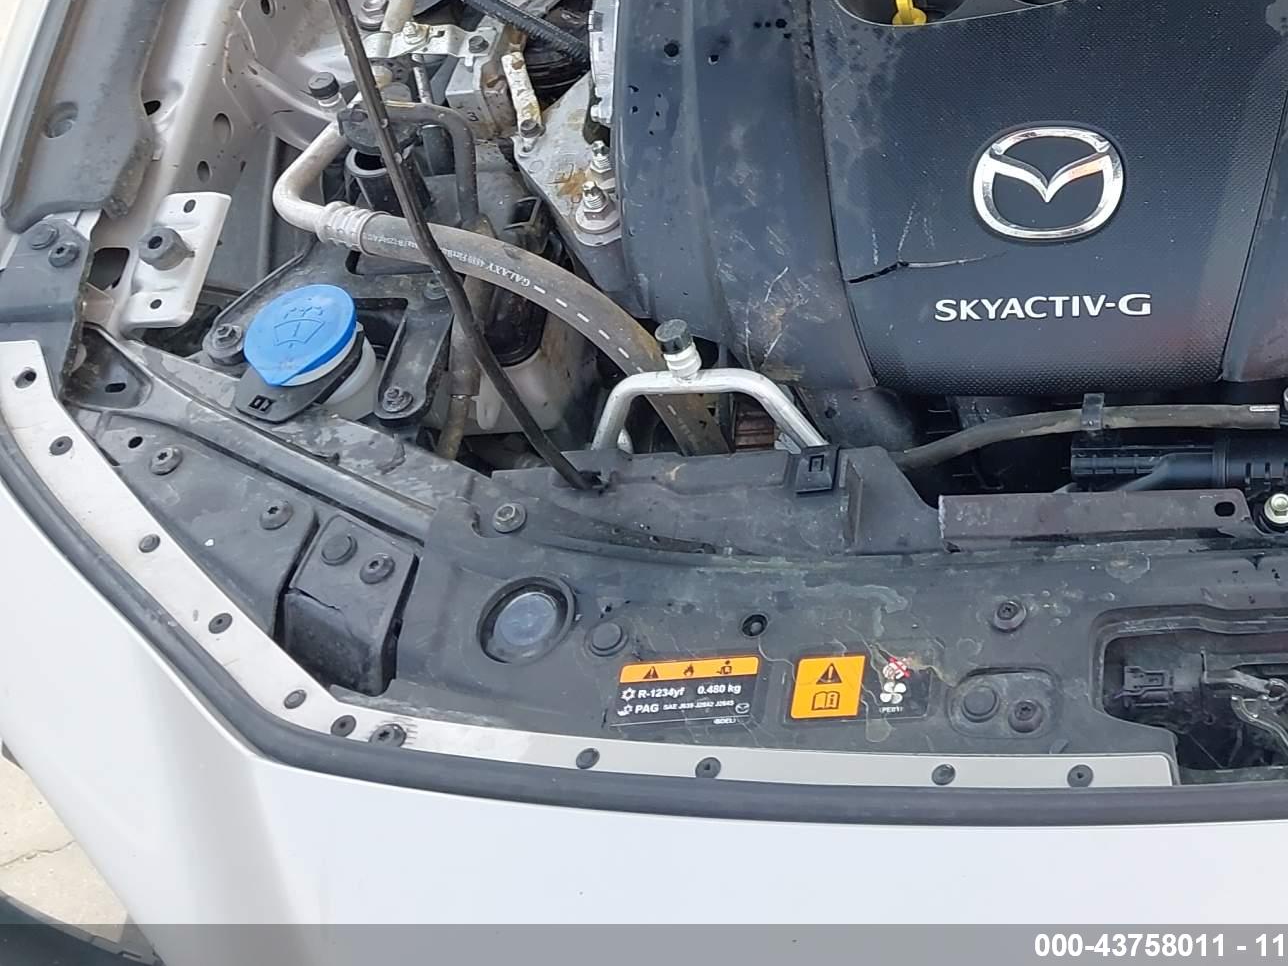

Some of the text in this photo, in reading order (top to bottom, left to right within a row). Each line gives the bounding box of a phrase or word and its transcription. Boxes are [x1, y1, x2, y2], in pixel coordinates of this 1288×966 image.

[485, 261, 531, 288] GALAXY
[934, 293, 1152, 322] SKYACTIV-G
[637, 684, 742, 699] R-1234yf 0.480 kg
[634, 703, 660, 715] PAG
[662, 702, 678, 711] SAE
